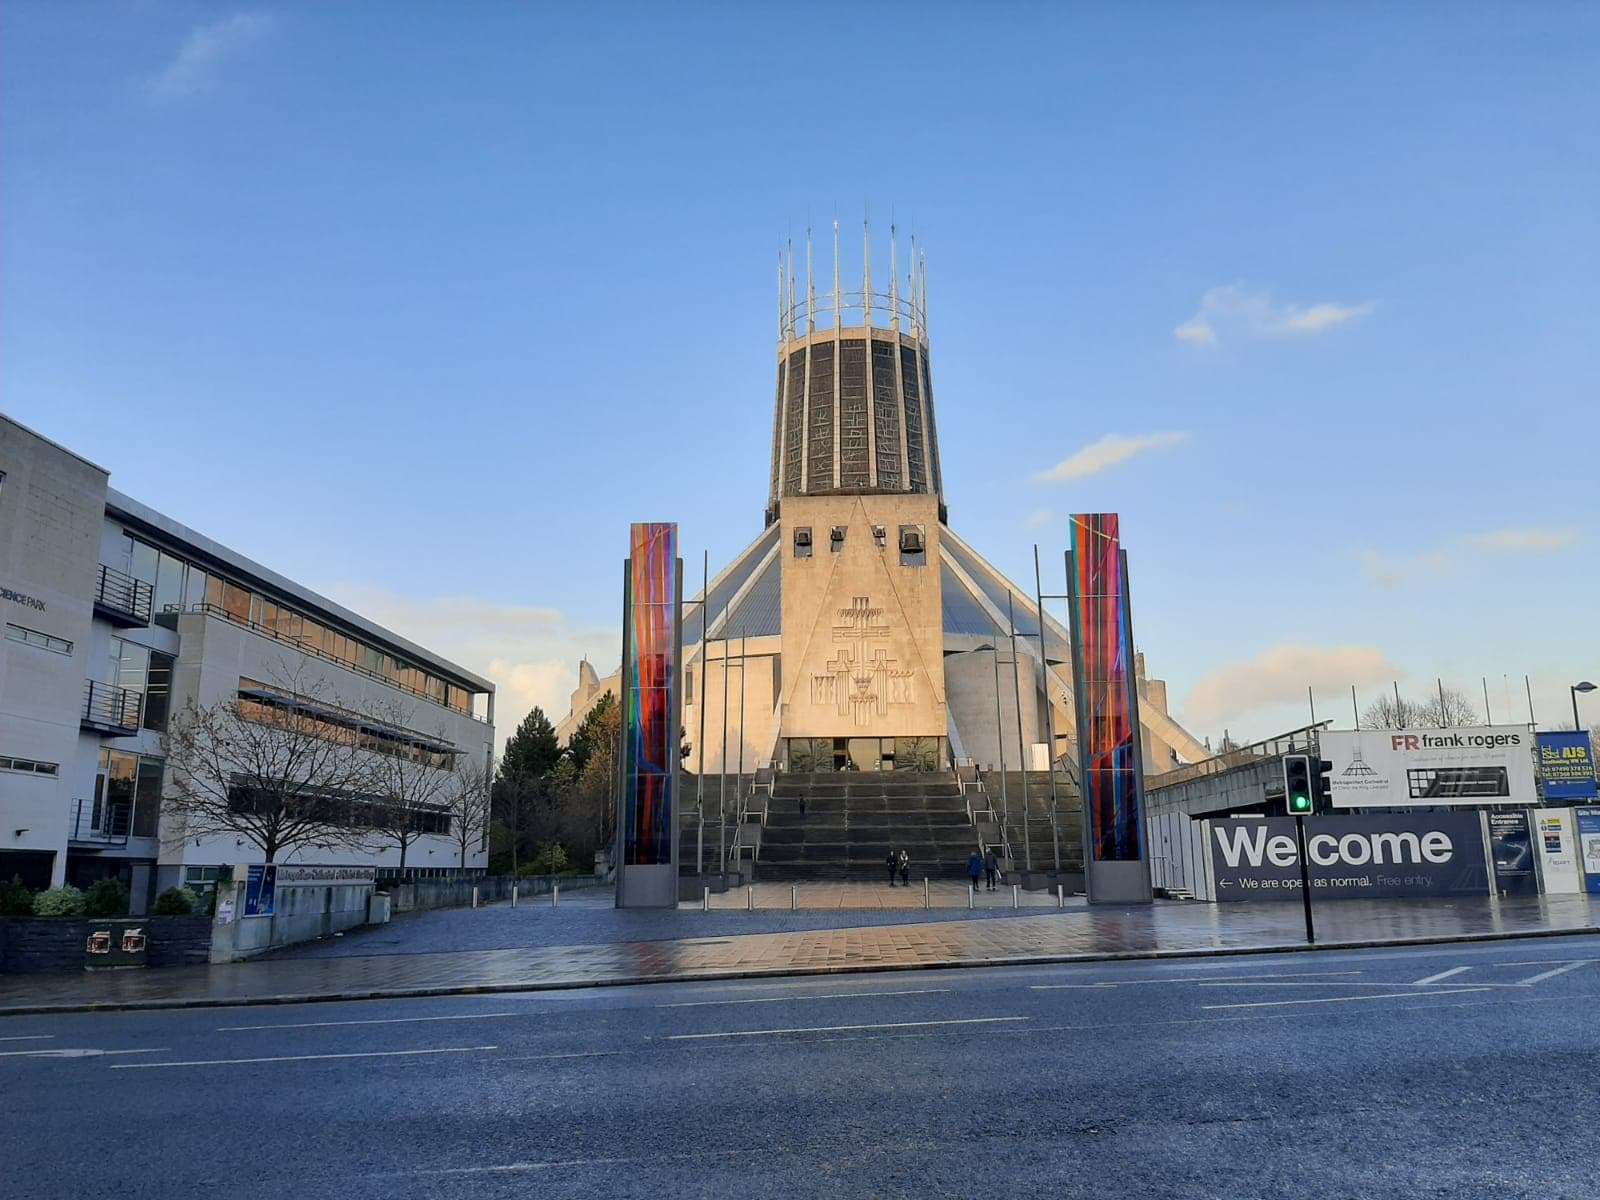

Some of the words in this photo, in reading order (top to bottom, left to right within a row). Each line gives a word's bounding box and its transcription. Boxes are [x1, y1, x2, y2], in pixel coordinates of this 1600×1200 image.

[27, 596, 45, 611] PARK
[1391, 735, 1420, 750] FR
[1422, 733, 1464, 747] frank
[1467, 734, 1521, 749] rogers
[1239, 878, 1258, 888] We
[1261, 879, 1279, 888] are
[1314, 878, 1328, 887] as
[1330, 876, 1372, 887] normal.
[1377, 875, 1400, 886] Free
[1404, 875, 1433, 887] entry.
